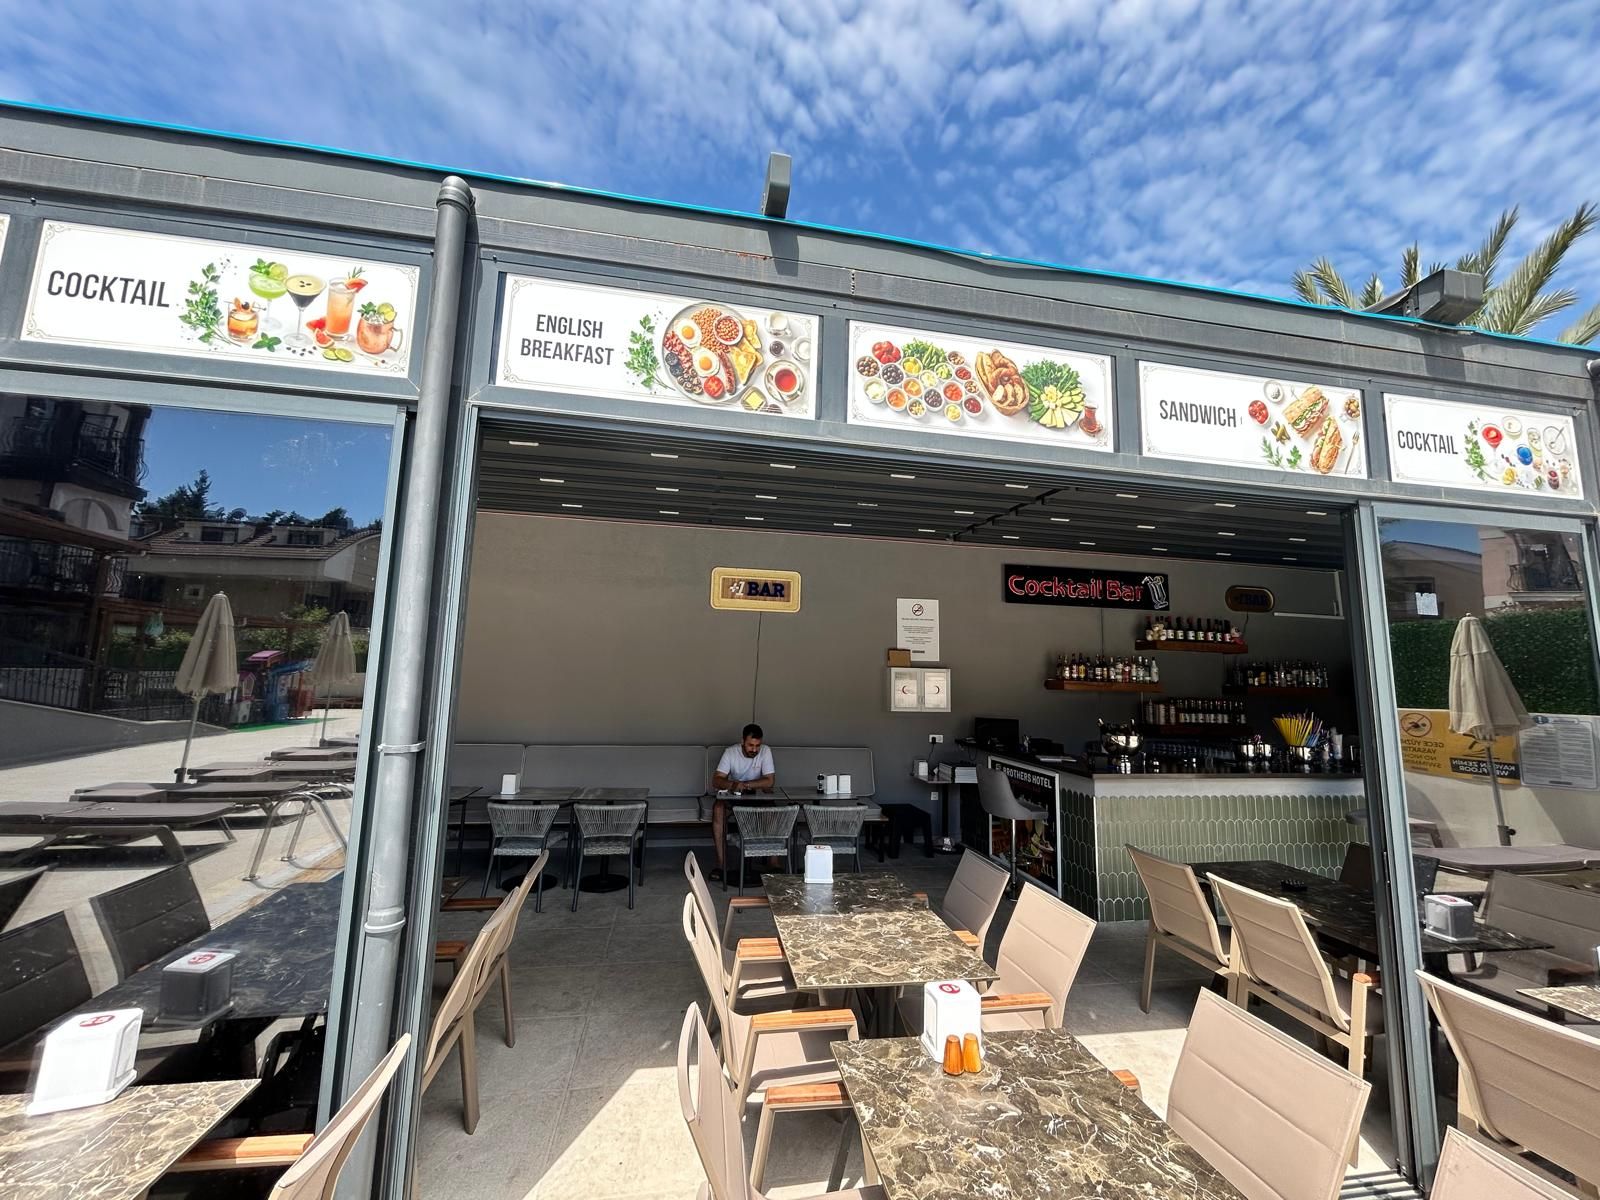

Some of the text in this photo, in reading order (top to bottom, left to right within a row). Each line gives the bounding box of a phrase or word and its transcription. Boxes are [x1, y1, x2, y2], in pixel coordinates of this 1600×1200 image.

[47, 270, 171, 309] COCKTAIL
[536, 313, 603, 339] ENGLISH
[520, 337, 614, 366] BREAKFAST
[1159, 399, 1237, 428] SANDWICH
[1397, 430, 1460, 456] COCKTAIL
[746, 581, 785, 598] BAR
[1007, 574, 1144, 602] Cocktail Bar
[1032, 774, 1053, 789] HOTEL
